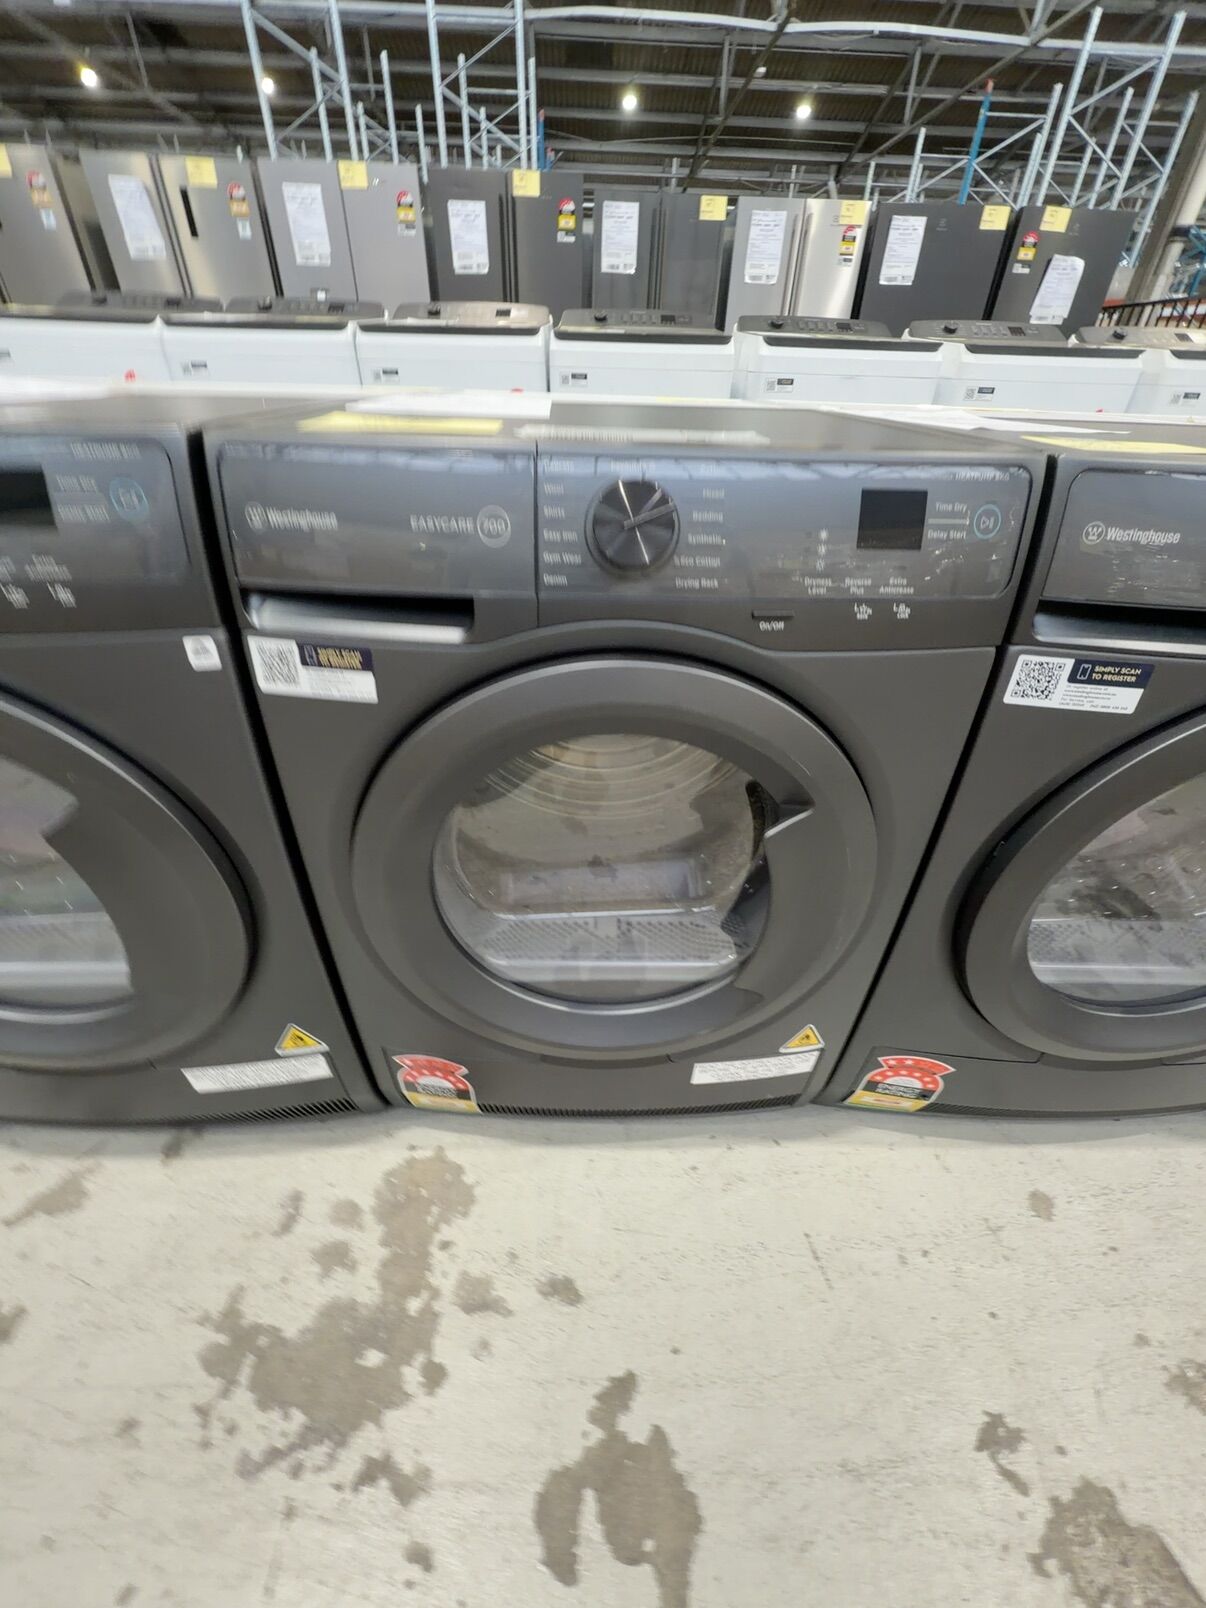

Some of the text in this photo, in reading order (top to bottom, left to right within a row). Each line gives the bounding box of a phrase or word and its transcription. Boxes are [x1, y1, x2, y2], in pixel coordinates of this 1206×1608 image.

[1107, 526, 1180, 545] Westinghouse
[1094, 665, 1120, 674] SIMPLY
[1102, 674, 1136, 682] REGISTER
